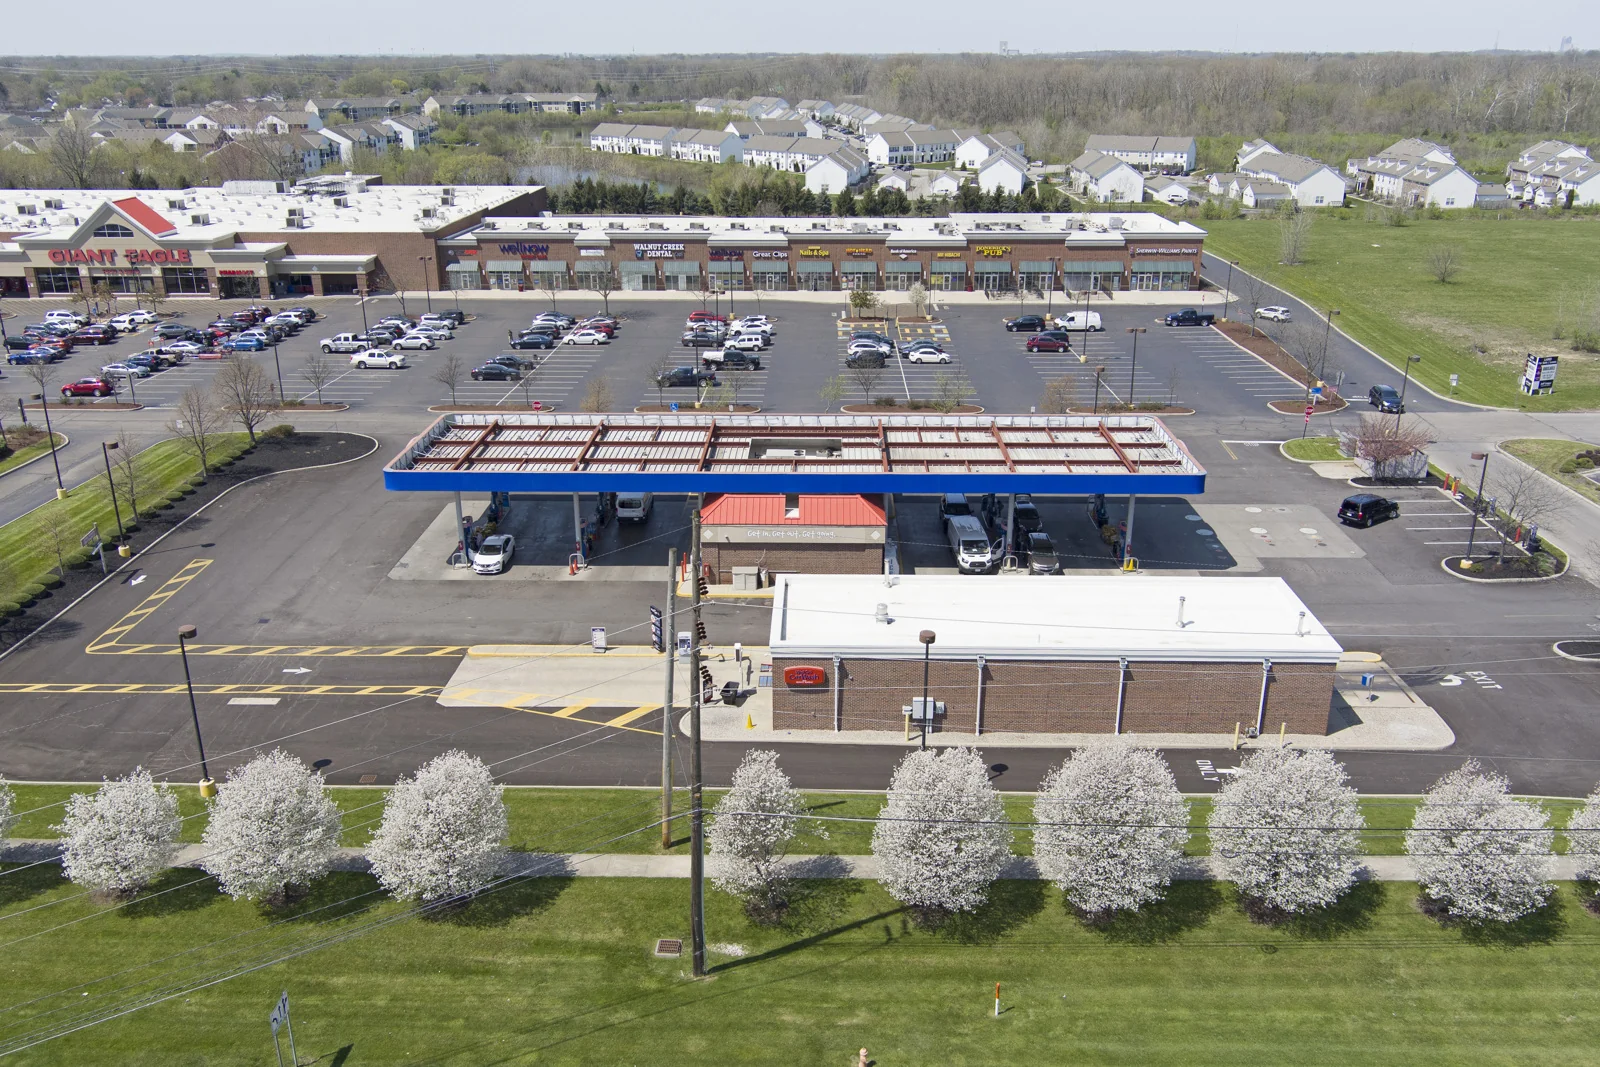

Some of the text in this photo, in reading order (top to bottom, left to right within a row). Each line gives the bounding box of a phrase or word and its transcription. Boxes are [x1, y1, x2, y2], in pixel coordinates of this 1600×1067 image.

[48, 249, 190, 263] GIANT EAGLE
[818, 249, 829, 257] Spa
[1464, 671, 1503, 689] EXIT
[1196, 760, 1220, 781] ONLY
